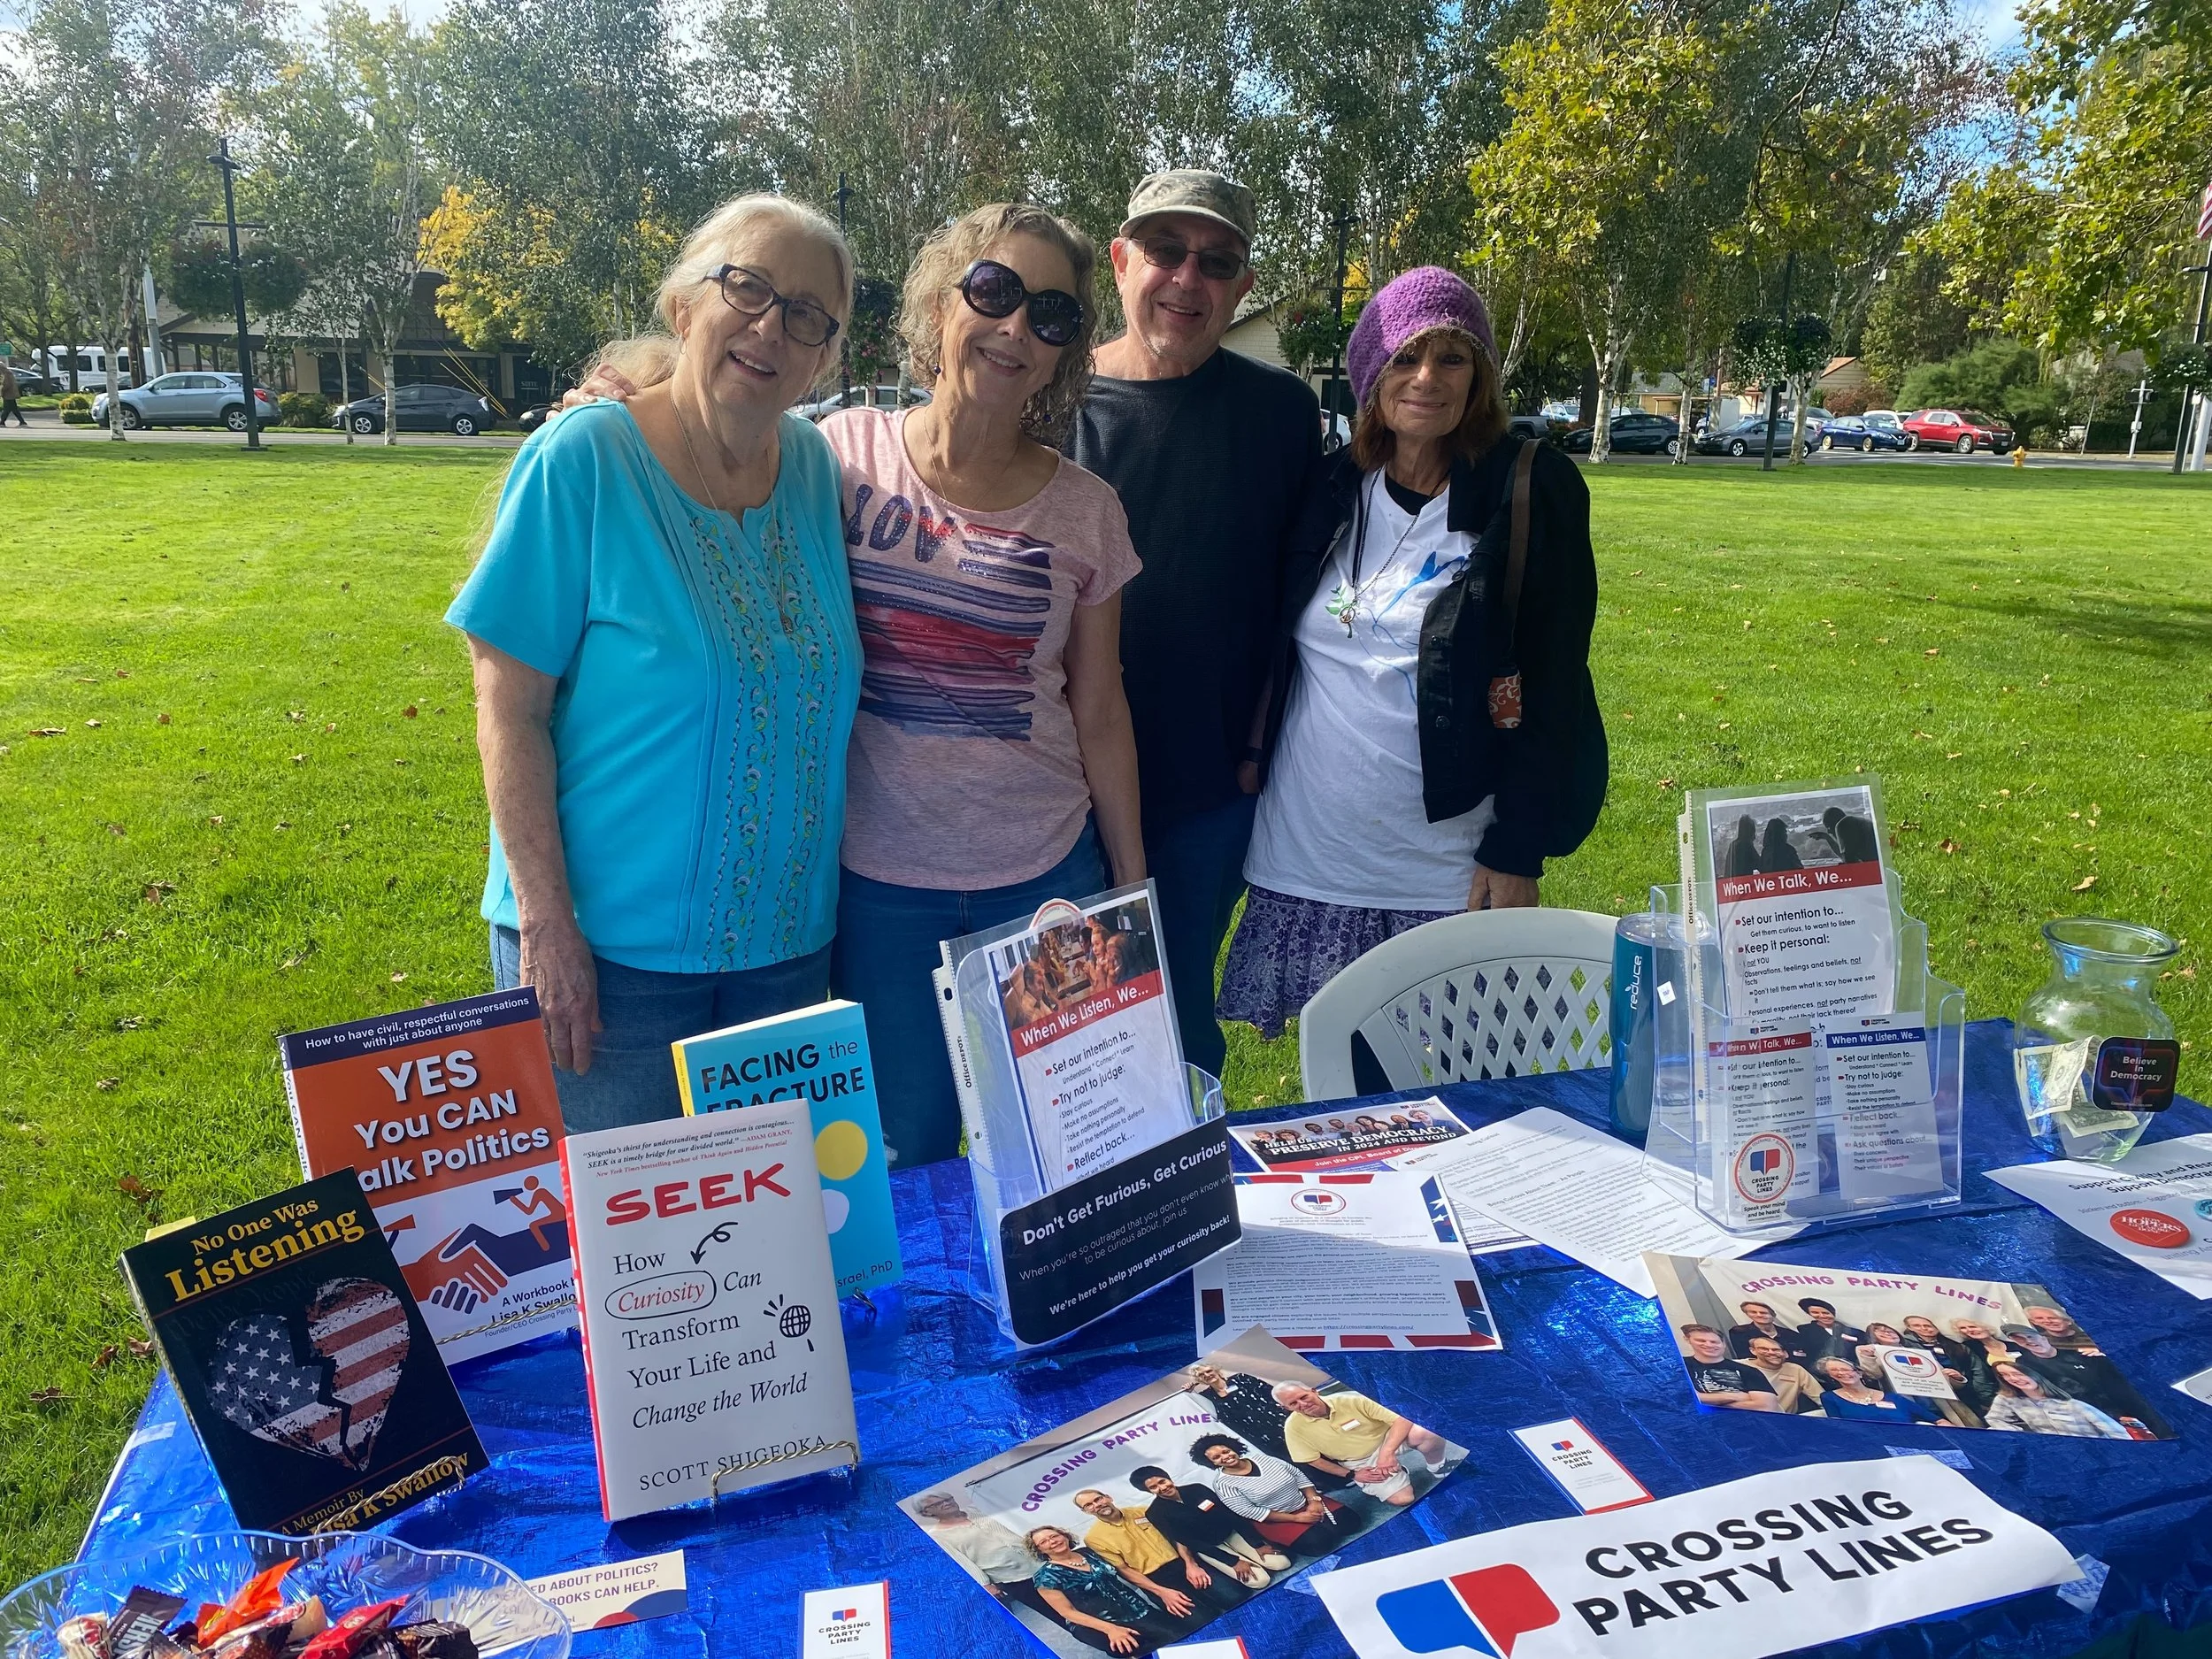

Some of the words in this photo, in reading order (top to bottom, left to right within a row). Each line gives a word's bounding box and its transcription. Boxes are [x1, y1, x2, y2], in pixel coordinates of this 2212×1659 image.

[1723, 881, 1751, 897] When
[1754, 878, 1775, 893] We
[1778, 873, 1811, 890] Talk,
[1816, 871, 1852, 885] We...
[1741, 914, 1755, 926] Set
[1757, 913, 1772, 924] our
[1775, 907, 1821, 922] intention
[1823, 906, 1844, 917] to...
[1762, 927, 1778, 936] them
[1778, 926, 1803, 935] curious,
[1745, 942, 1769, 955] Keep
[1770, 941, 1778, 950] it
[1780, 934, 1830, 951] personal:
[1630, 955, 1643, 1010] reduce
[305, 1036, 331, 1048] How
[334, 1033, 345, 1043] to
[348, 1028, 374, 1041] have
[377, 1023, 402, 1035] civil,
[404, 1010, 457, 1030] respectful
[459, 997, 529, 1018] conversations
[363, 1033, 387, 1049] with
[388, 1030, 409, 1046] just
[412, 1025, 442, 1039] about
[445, 1018, 482, 1034] anyone
[1021, 1021, 1057, 1047] When
[1058, 1012, 1078, 1030] We
[1079, 997, 1115, 1021] Listen,
[1117, 987, 1148, 1003] We...
[1053, 1059, 1067, 1074] Set
[1069, 1054, 1081, 1067] our
[1083, 1036, 1118, 1060] intention
[1119, 1031, 1136, 1041] to...
[1832, 1035, 1857, 1045] When
[1859, 1033, 1873, 1042] We
[1876, 1033, 1900, 1041] Listen,
[378, 1049, 478, 1102] YES
[701, 1044, 820, 1094] FACING
[828, 1041, 858, 1061] the
[2110, 1070, 2162, 1082] Democracy
[2123, 1056, 2157, 1065] Believe
[1059, 1092, 1071, 1104] Try
[1074, 1081, 1088, 1097] not
[1089, 1079, 1097, 1089] to
[1099, 1064, 1125, 1087] judge:
[354, 1113, 429, 1149] You
[437, 1089, 517, 1130] CAN
[623, 1143, 641, 1153] thirst
[641, 1141, 651, 1151] for
[653, 1134, 699, 1148] understanding
[700, 1130, 712, 1140] and
[713, 1126, 747, 1138] connection
[1074, 1144, 1104, 1170] Reflect
[1105, 1133, 1135, 1151] back...
[1264, 1141, 1294, 1149] HELP
[1271, 1138, 1350, 1156] PRESERVE
[1351, 1125, 1448, 1145] DEMOCRACY
[1355, 1141, 1381, 1149] 2024
[1384, 1136, 1408, 1145] AND
[1409, 1132, 1456, 1142] BEYOND
[358, 1155, 417, 1192] alk
[423, 1126, 549, 1177] Politics
[606, 1163, 791, 1226] SEEK
[1023, 1215, 1065, 1246] Don't
[1067, 1202, 1093, 1225] Get
[1094, 1179, 1151, 1211] Furious,
[1153, 1162, 1178, 1183] Get
[1179, 1140, 1227, 1171] Curious
[1752, 1175, 1779, 1184] CROSSING
[2069, 1179, 2117, 1190] Support
[2107, 1181, 2158, 1194] Support
[190, 1233, 225, 1256] No
[227, 1211, 273, 1243] One
[273, 1198, 319, 1225] Was
[1019, 1264, 1049, 1281] When
[1051, 1249, 1077, 1272] you're
[1079, 1245, 1089, 1256] so
[1090, 1225, 1125, 1250] outraged
[1126, 1216, 1143, 1233] that
[1144, 1210, 1158, 1228] you
[1160, 1198, 1179, 1216] don't
[1180, 1190, 1199, 1204] even
[1200, 1181, 1219, 1196] know
[1084, 1255, 1094, 1265] to
[1095, 1248, 1105, 1260] be
[1107, 1233, 1135, 1253] curious
[1137, 1220, 1160, 1239] about,
[1162, 1211, 1177, 1227] join
[1179, 1208, 1187, 1218] us
[165, 1208, 366, 1302] Listening
[613, 1252, 666, 1276] How
[872, 1260, 893, 1279] PhD
[1049, 1294, 1077, 1315] We're
[1079, 1283, 1097, 1302] here
[1098, 1279, 1107, 1290] to
[1109, 1270, 1126, 1286] help
[1127, 1262, 1143, 1279] you
[1143, 1250, 1157, 1268] get
[1157, 1243, 1176, 1262] your
[1177, 1224, 1210, 1249] curiosity
[1210, 1214, 1230, 1233] back!
[503, 1297, 511, 1307] A
[512, 1280, 569, 1303] Workbook
[618, 1282, 705, 1311] Curiosity
[724, 1269, 763, 1292] Can
[1742, 1275, 1834, 1294] CROSSING
[1847, 1277, 1919, 1291] PARTY
[1935, 1285, 2002, 1310] LINES
[622, 1314, 741, 1351] Transform
[627, 1365, 681, 1389] Your
[688, 1351, 731, 1377] Life
[738, 1340, 777, 1367] and
[633, 1399, 706, 1429] Change
[713, 1388, 741, 1412] the
[750, 1372, 807, 1403] World
[640, 1461, 709, 1491] SCOTT
[718, 1434, 826, 1472] SHIGEOKA
[1022, 1449, 1097, 1513] CROSSING
[1102, 1422, 1159, 1450] PARTY
[1552, 1449, 1593, 1462] CROSSING
[1563, 1455, 1589, 1464] PARTY
[1570, 1461, 1593, 1470] LINES
[383, 1452, 469, 1508] Swallow
[280, 1526, 291, 1536] A
[293, 1499, 345, 1532] Memoir
[348, 1487, 365, 1503] By
[1585, 1490, 1913, 1579] CROSSING
[549, 1574, 592, 1591] ABOUT
[595, 1562, 658, 1583] POLITICS?
[549, 1591, 590, 1606] BOOKS
[595, 1586, 620, 1599] CAN
[624, 1579, 659, 1594] HELP.
[1571, 1556, 1794, 1637] PARTY
[1804, 1518, 1994, 1581] LINES
[818, 1622, 871, 1632] CROSSING
[828, 1629, 861, 1638] PARTY
